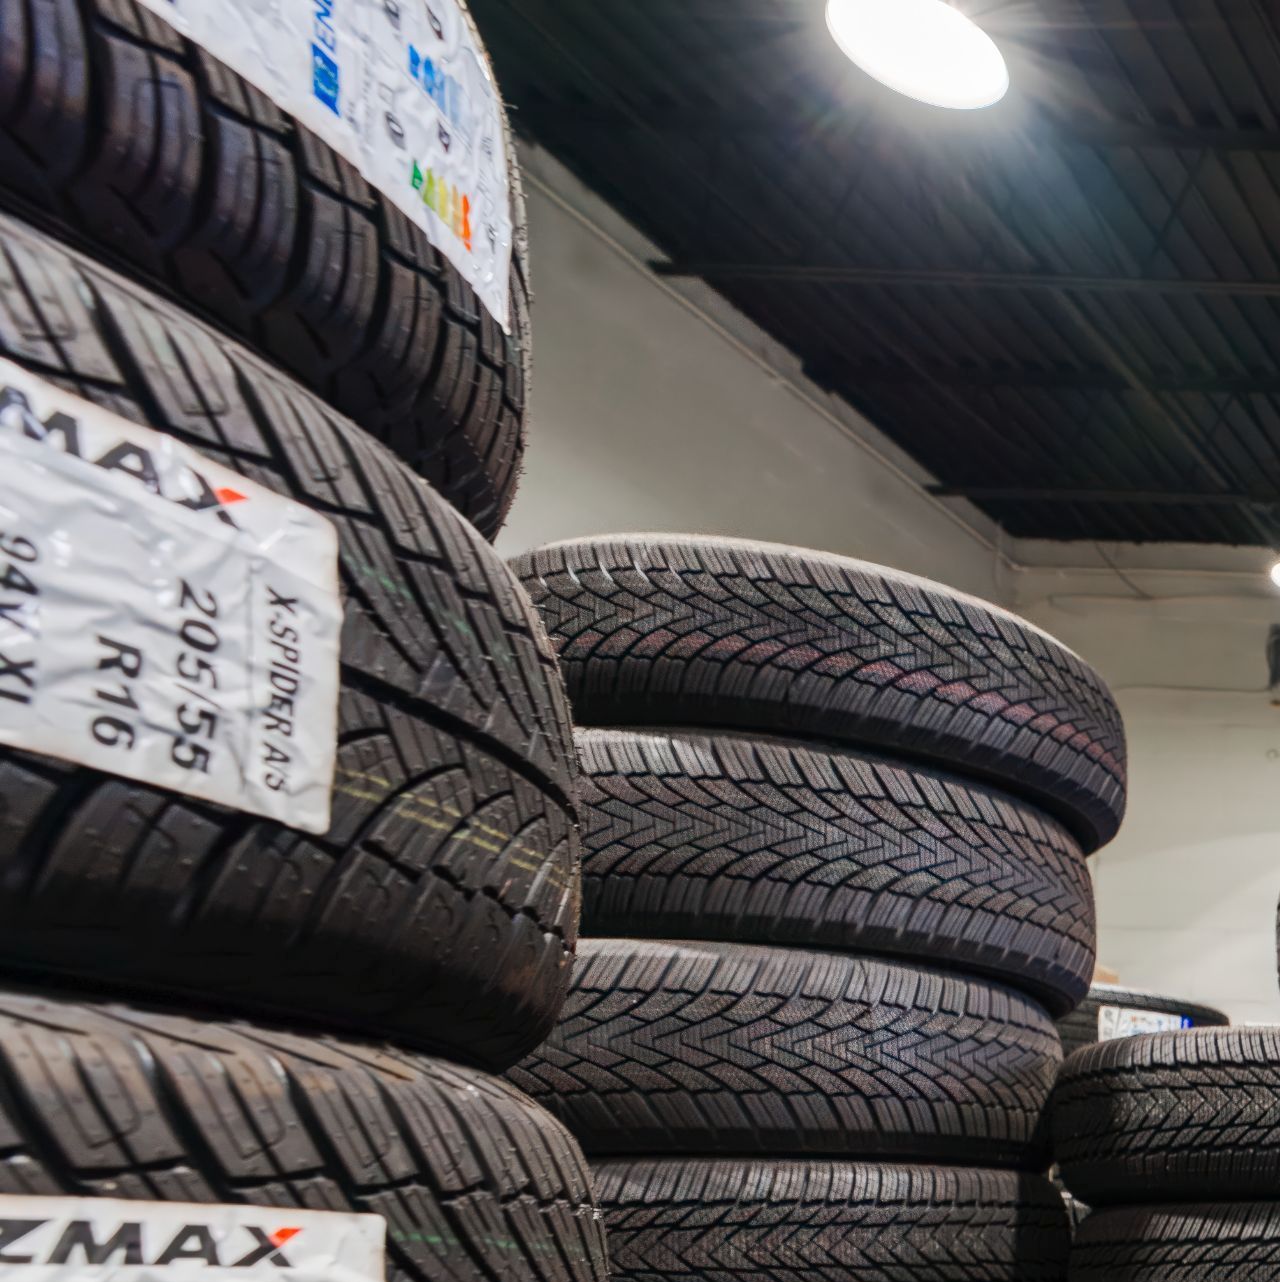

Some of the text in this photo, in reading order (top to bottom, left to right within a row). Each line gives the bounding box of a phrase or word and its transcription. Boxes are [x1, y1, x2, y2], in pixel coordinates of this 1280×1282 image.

[90, 634, 144, 751] R16
[172, 577, 222, 775] 205/55
[0, 1218, 301, 1267] ZMAX
